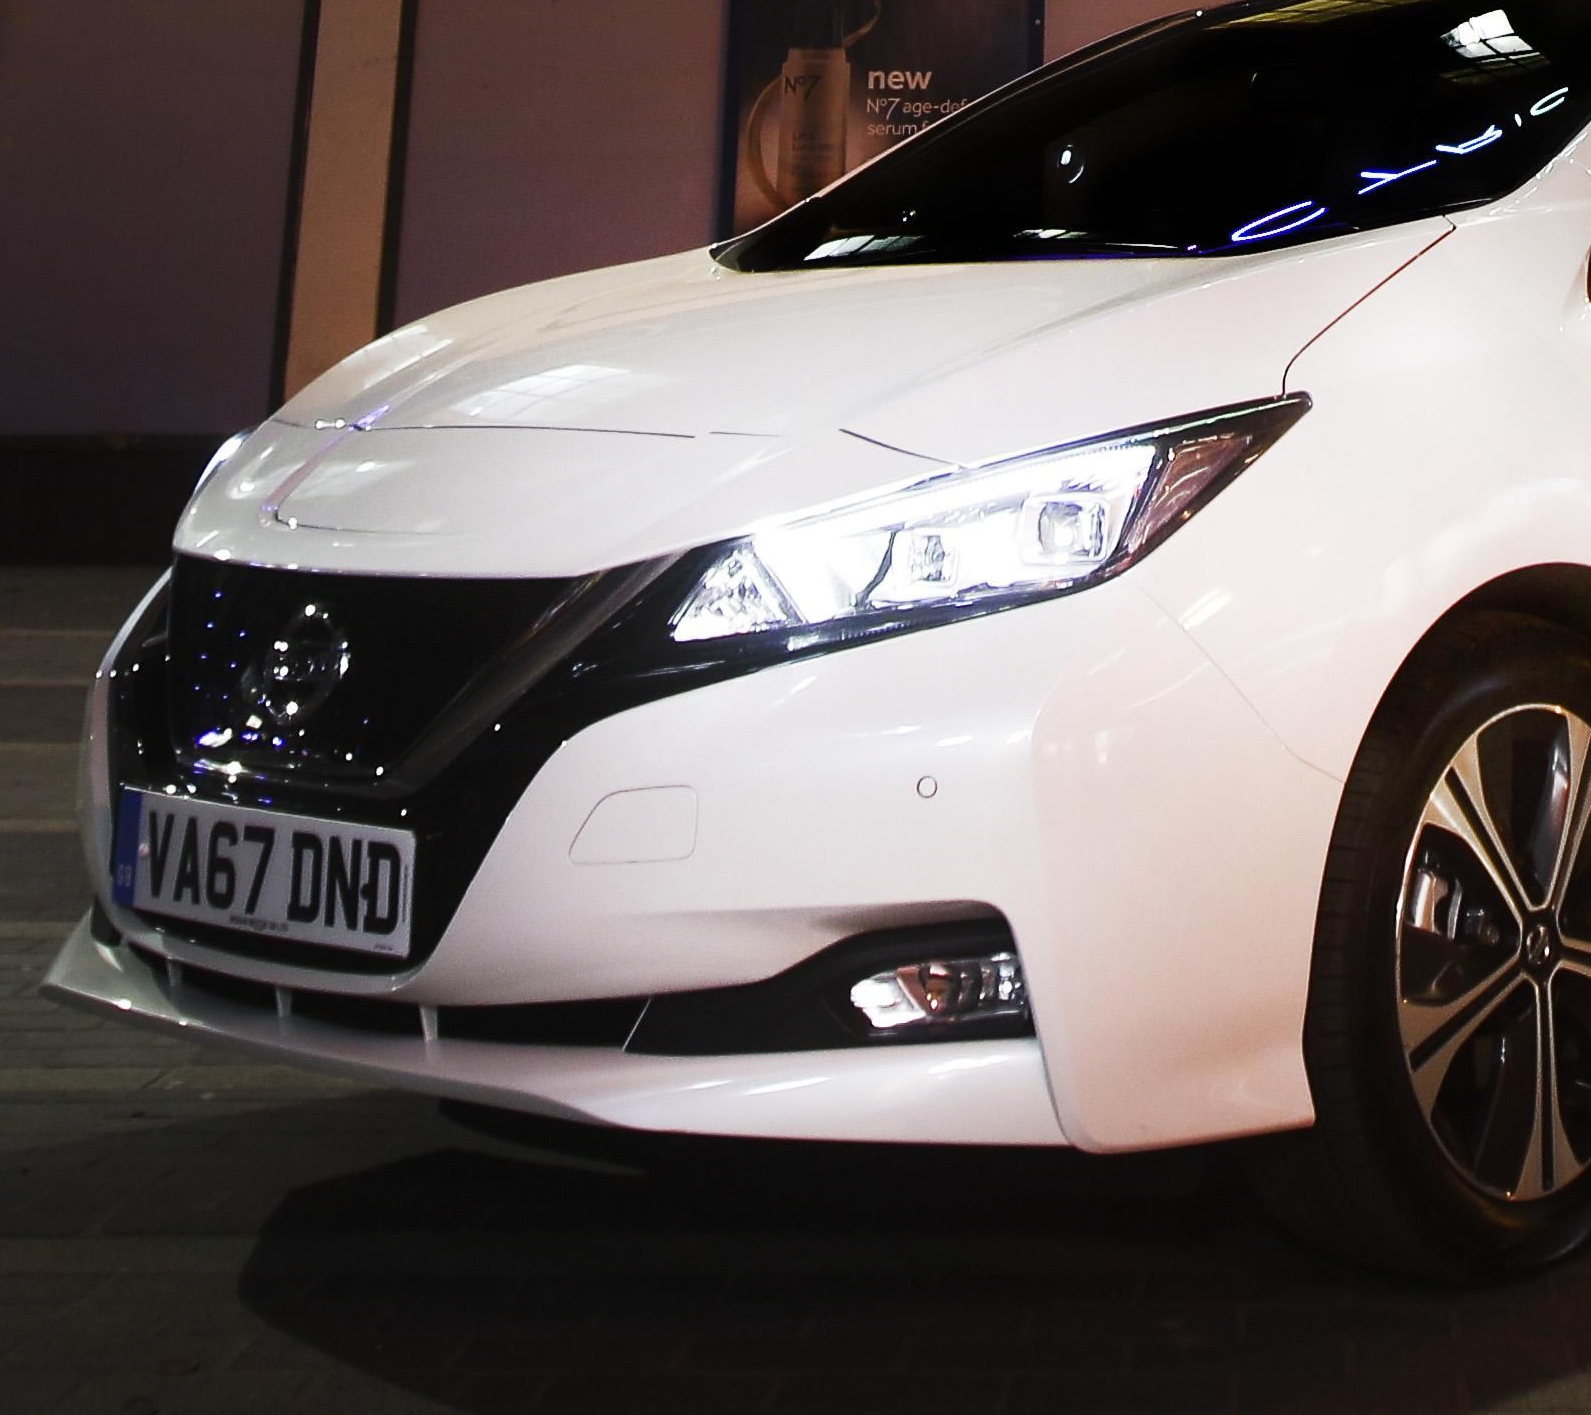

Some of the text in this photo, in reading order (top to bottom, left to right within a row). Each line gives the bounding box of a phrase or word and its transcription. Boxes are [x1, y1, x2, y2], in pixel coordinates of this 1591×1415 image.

[867, 70, 933, 90] new
[902, 98, 969, 118] age-def
[867, 122, 919, 136] serum
[147, 810, 402, 936] VA67 DND
